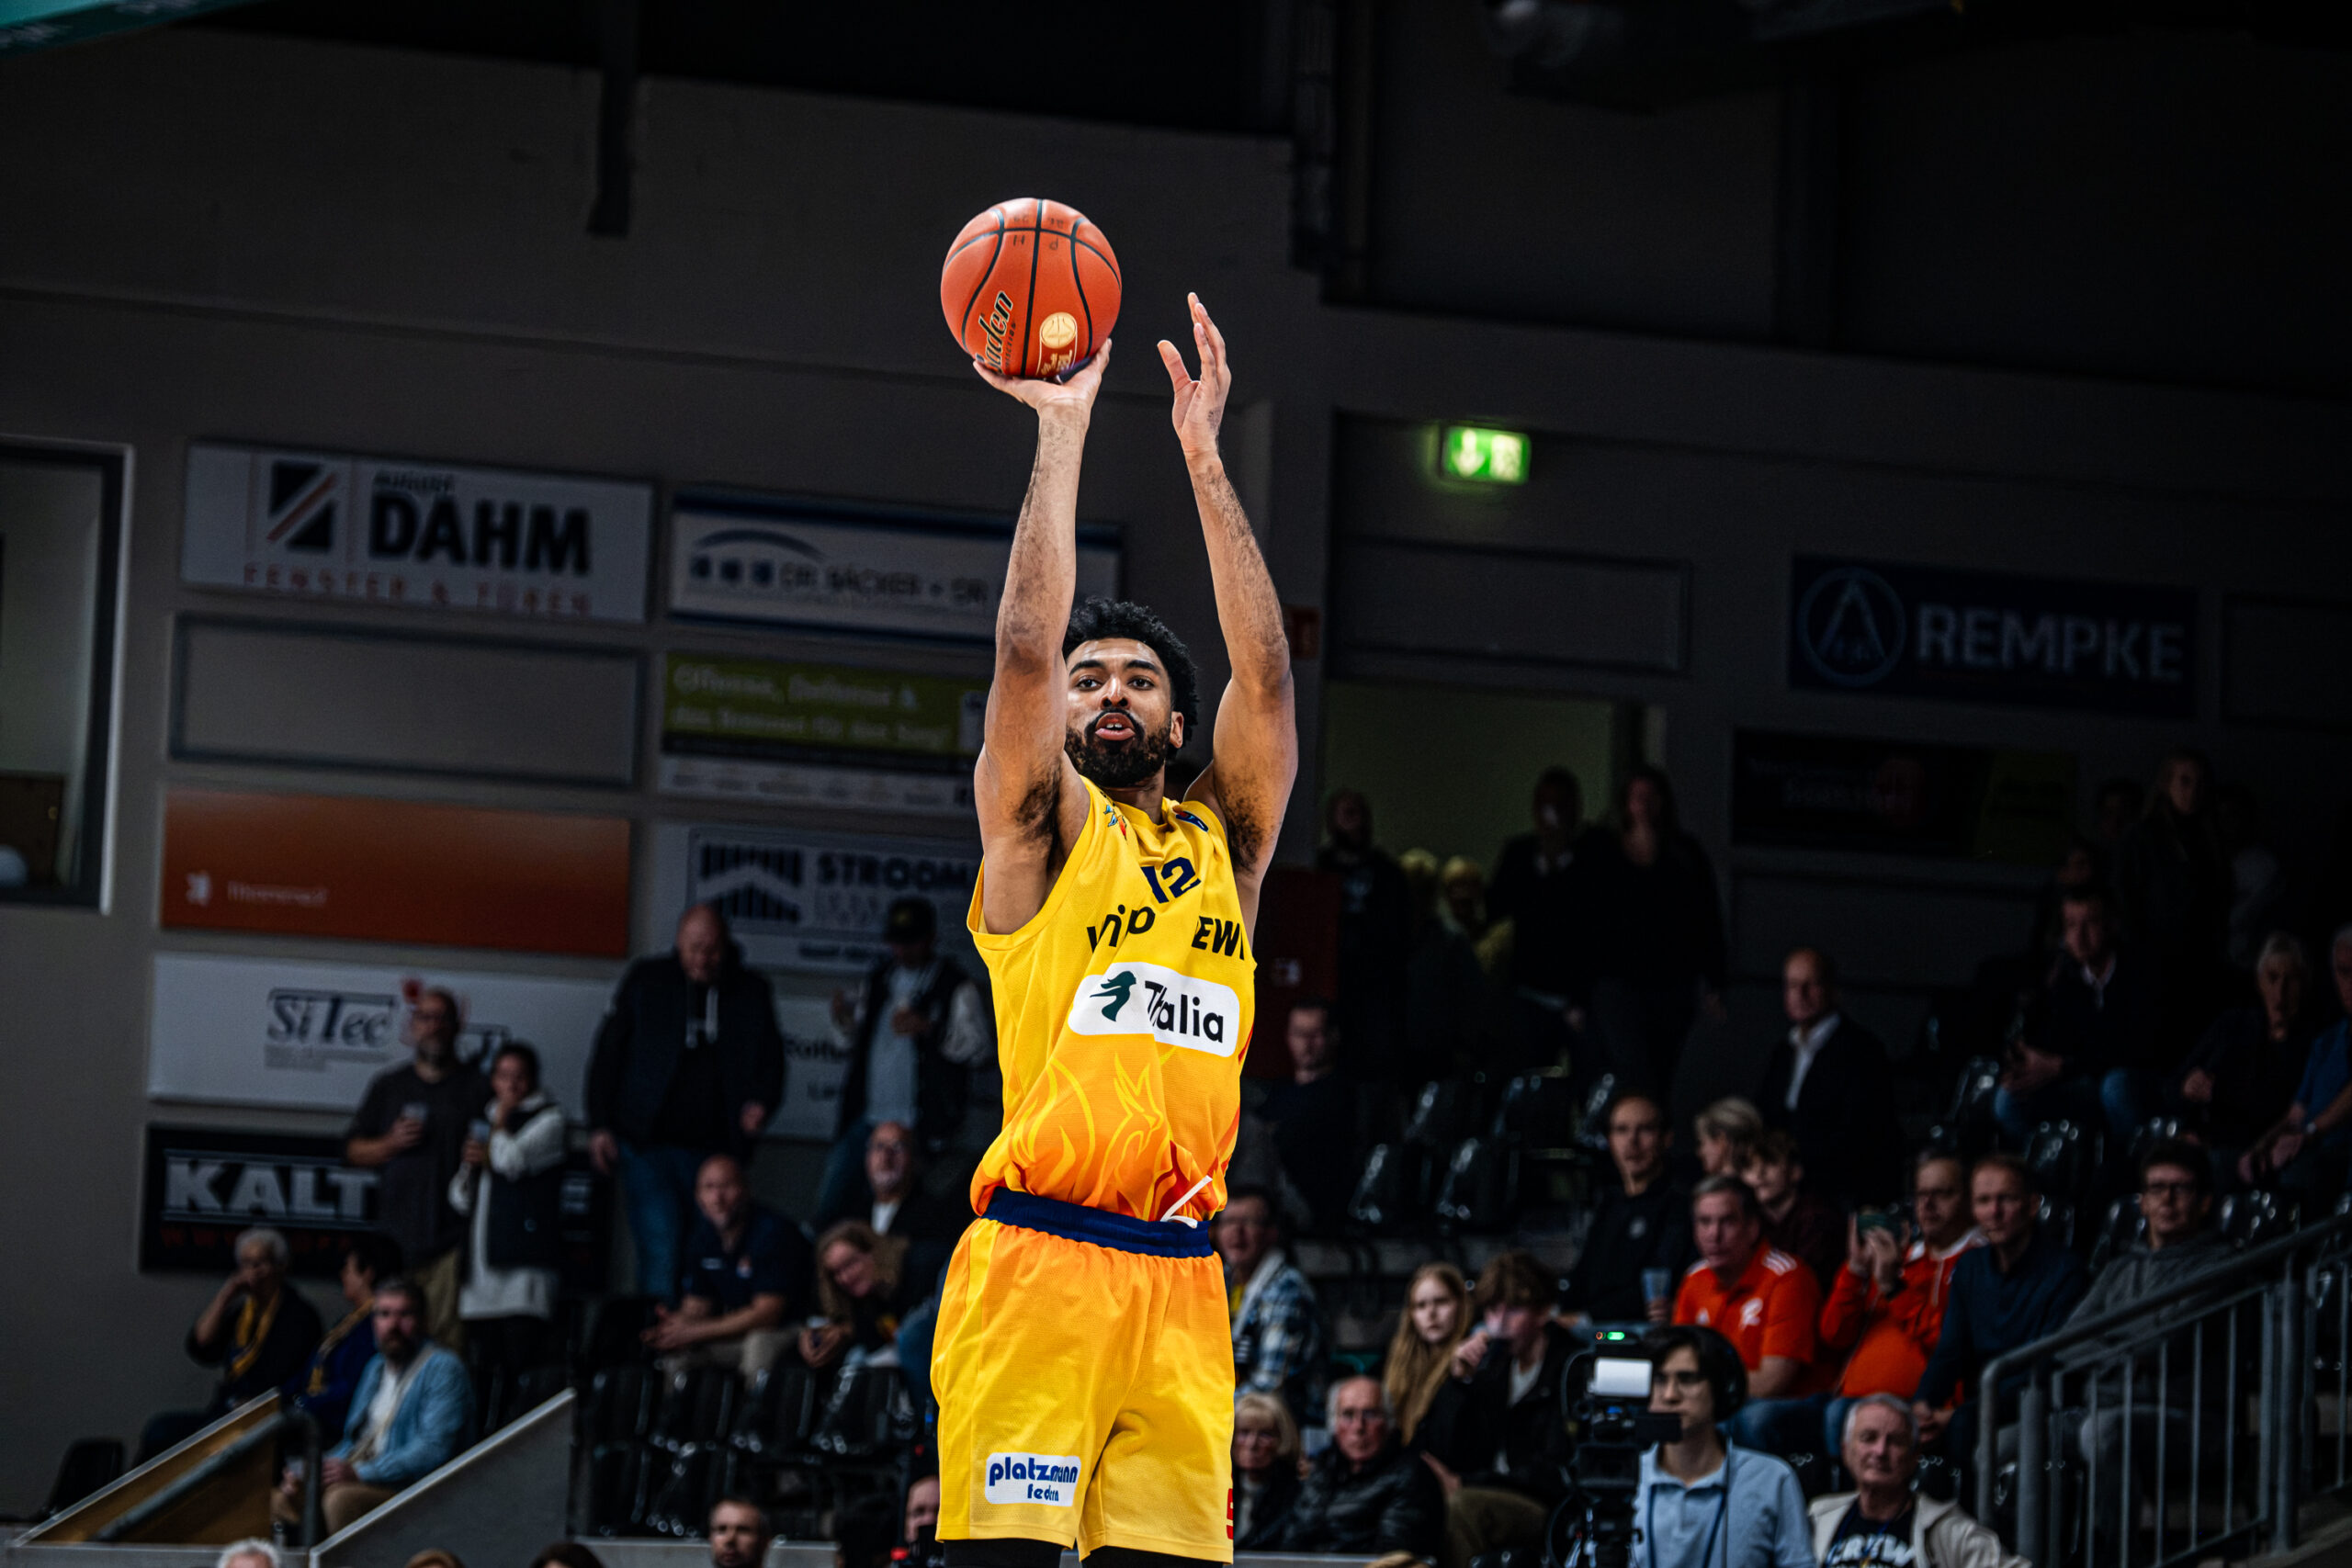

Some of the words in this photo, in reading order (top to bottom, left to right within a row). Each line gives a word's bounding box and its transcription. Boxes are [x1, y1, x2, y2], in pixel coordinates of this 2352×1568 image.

[370, 490, 591, 576] DAHM
[243, 561, 406, 603] FENSTER
[1916, 601, 2186, 684] REMPKE
[818, 850, 978, 892] STROOM
[1141, 856, 1201, 904] 12
[267, 988, 393, 1046] SiTec
